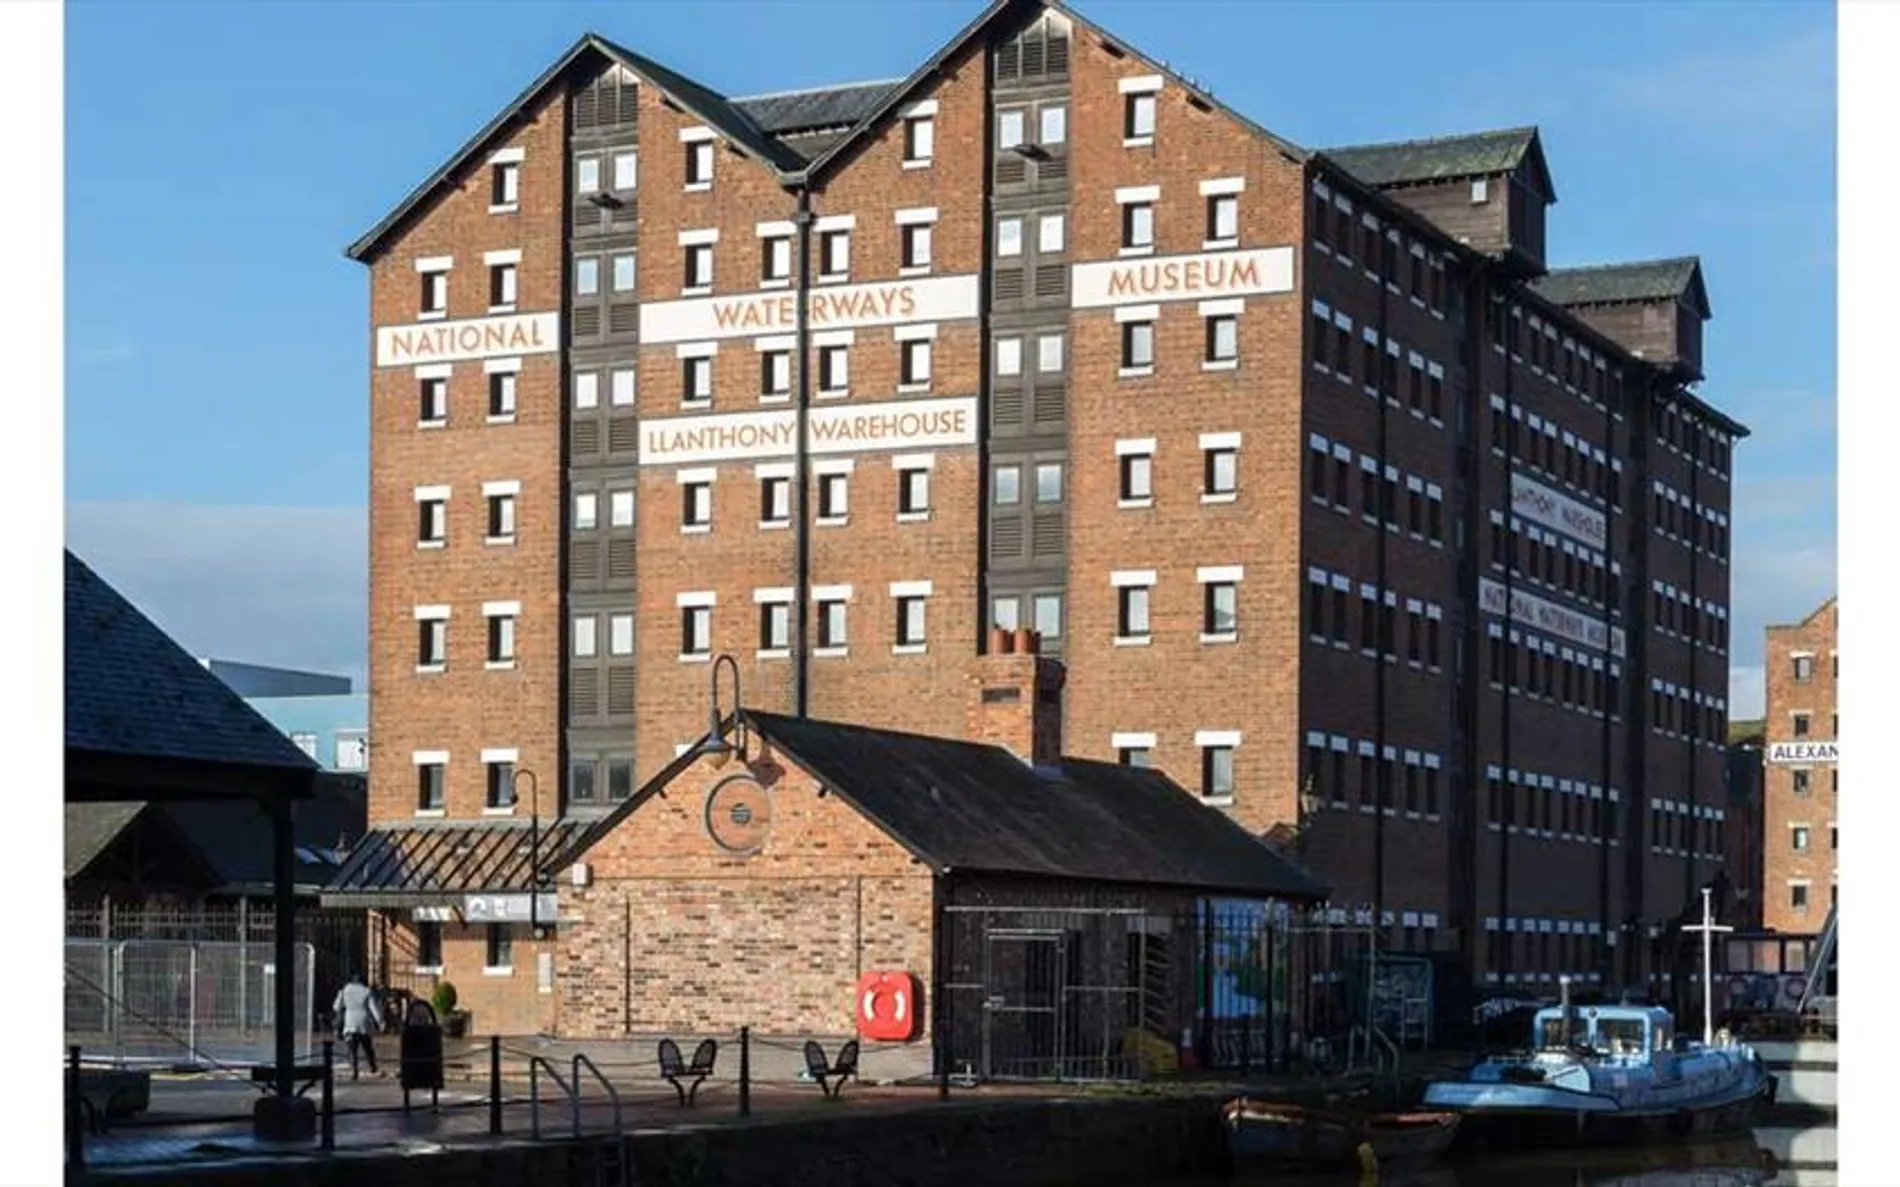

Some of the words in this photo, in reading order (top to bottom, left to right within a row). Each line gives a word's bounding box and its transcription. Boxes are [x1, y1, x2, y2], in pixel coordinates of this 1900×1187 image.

[1107, 258, 1261, 297] MUSEUM
[713, 285, 916, 329] WATERWAYS
[391, 319, 544, 358] NATIONAL
[648, 421, 796, 454] LLANTHONY
[810, 408, 967, 441] WAREHOUSE
